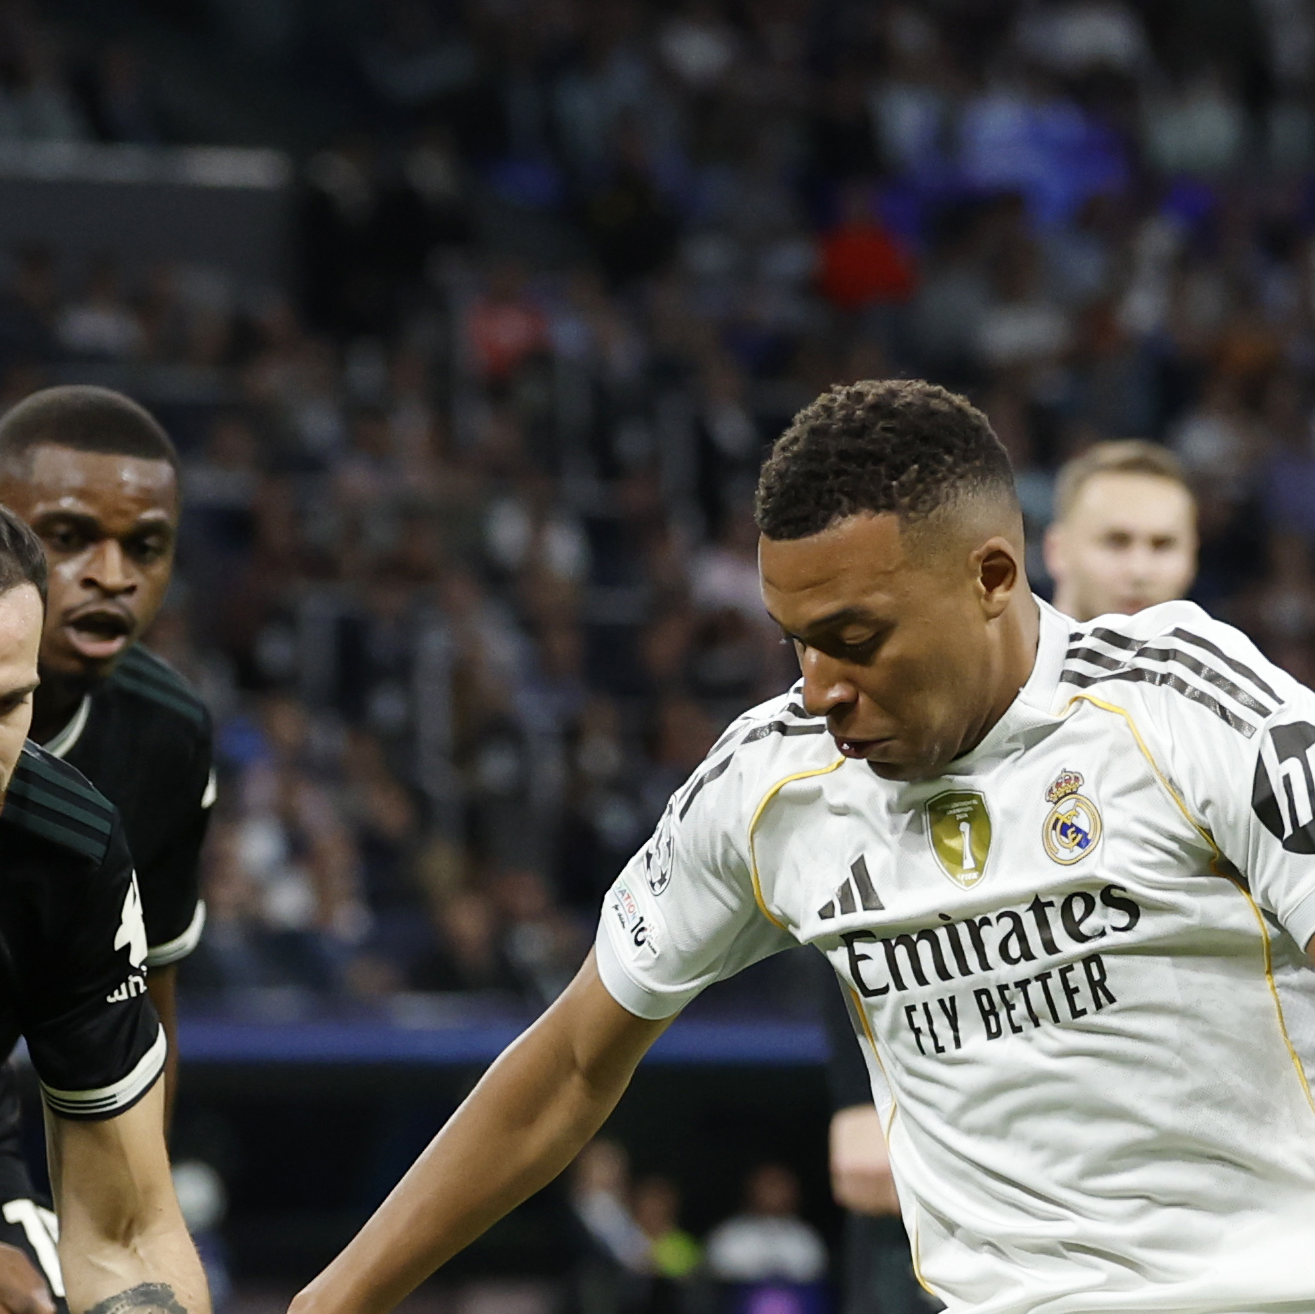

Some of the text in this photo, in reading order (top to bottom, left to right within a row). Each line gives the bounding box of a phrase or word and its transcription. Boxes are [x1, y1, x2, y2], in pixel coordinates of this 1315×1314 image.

[839, 883, 1141, 999] Emirates
[904, 953, 1118, 1056] FLY BETTER
[1, 1198, 66, 1298] 1
